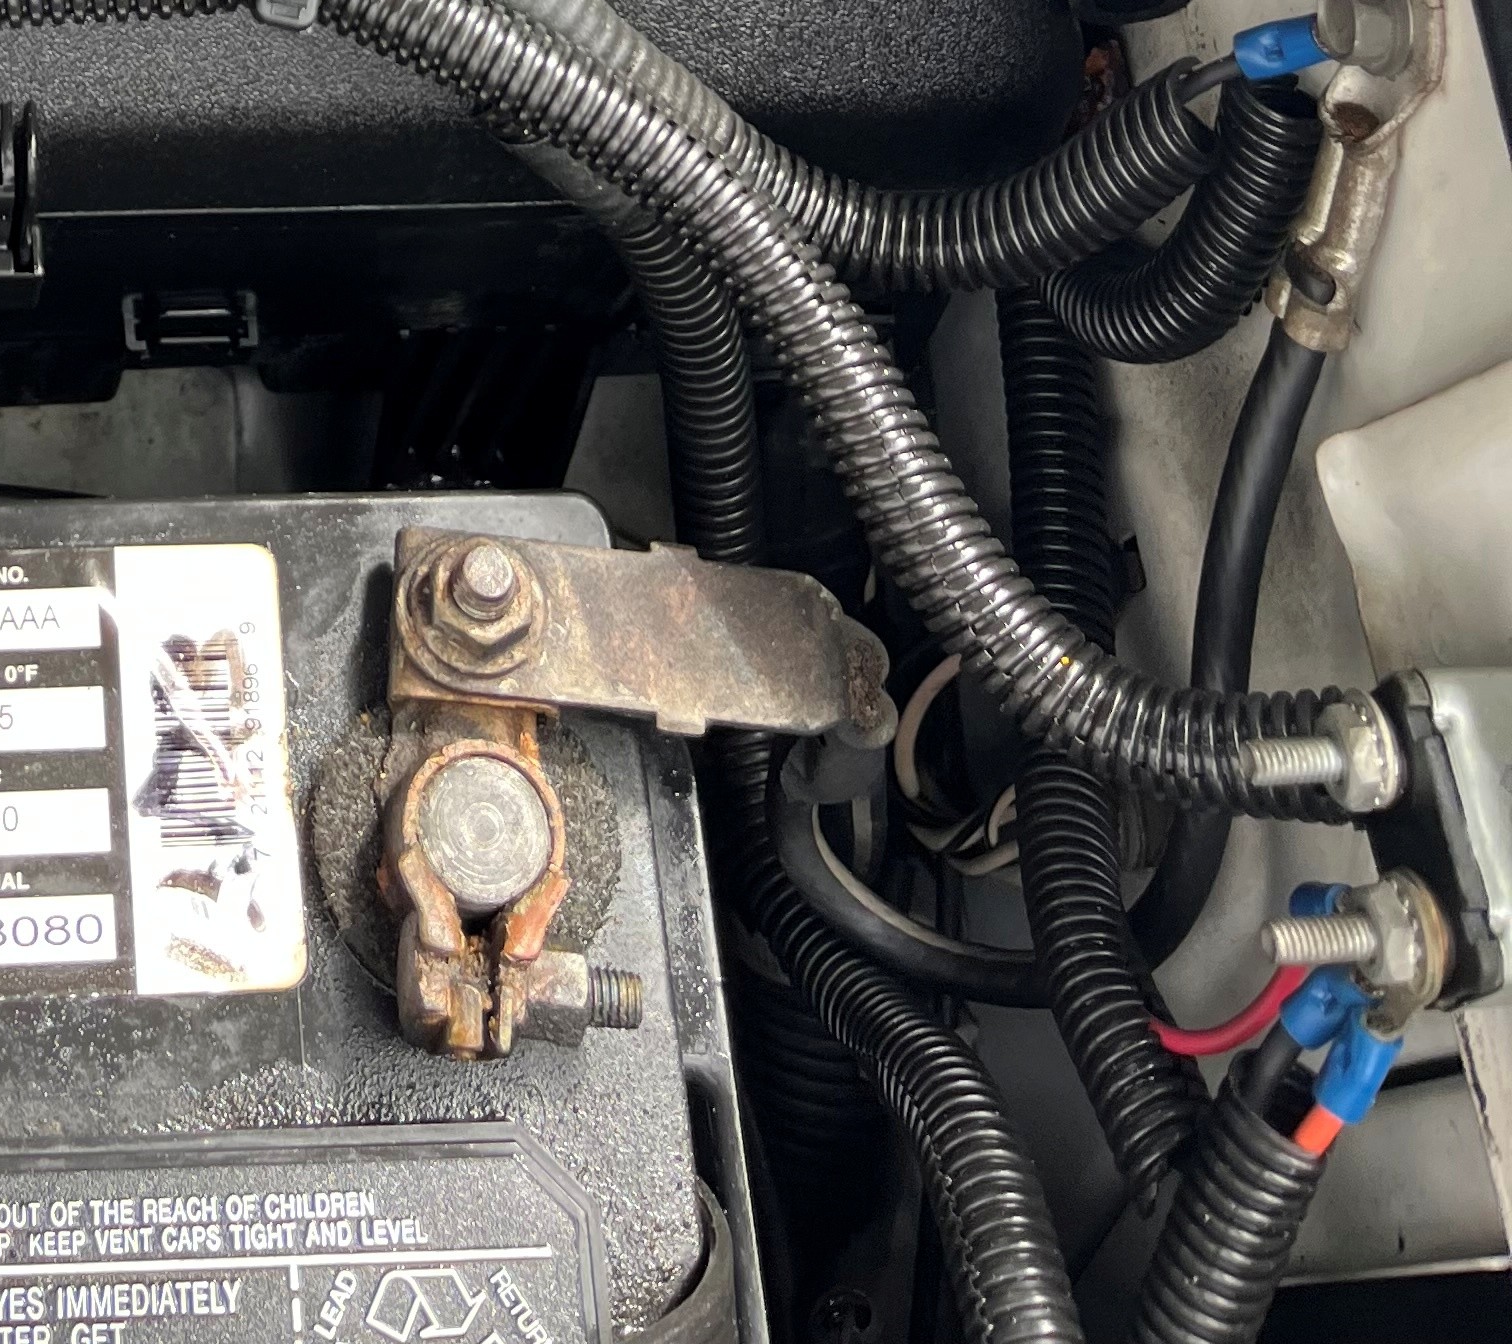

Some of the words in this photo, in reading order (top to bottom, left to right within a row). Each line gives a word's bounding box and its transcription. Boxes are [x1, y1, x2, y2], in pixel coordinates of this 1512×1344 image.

[4, 664, 39, 684] 0°F
[50, 1199, 82, 1227] OF
[90, 1198, 134, 1225] THE
[142, 1196, 218, 1224] REACH
[225, 1194, 256, 1222] OF
[264, 1191, 375, 1220] CHILDREN
[29, 1229, 86, 1257] KEEP
[95, 1226, 153, 1255] VENT
[161, 1224, 222, 1252] CAPS
[229, 1221, 298, 1250] TIGHT
[305, 1219, 354, 1248] AND
[360, 1217, 429, 1246] LEVEL
[57, 1278, 241, 1320] IMMEDIATELY
[313, 1269, 358, 1340] LEAD
[489, 1265, 553, 1344] RETUR
